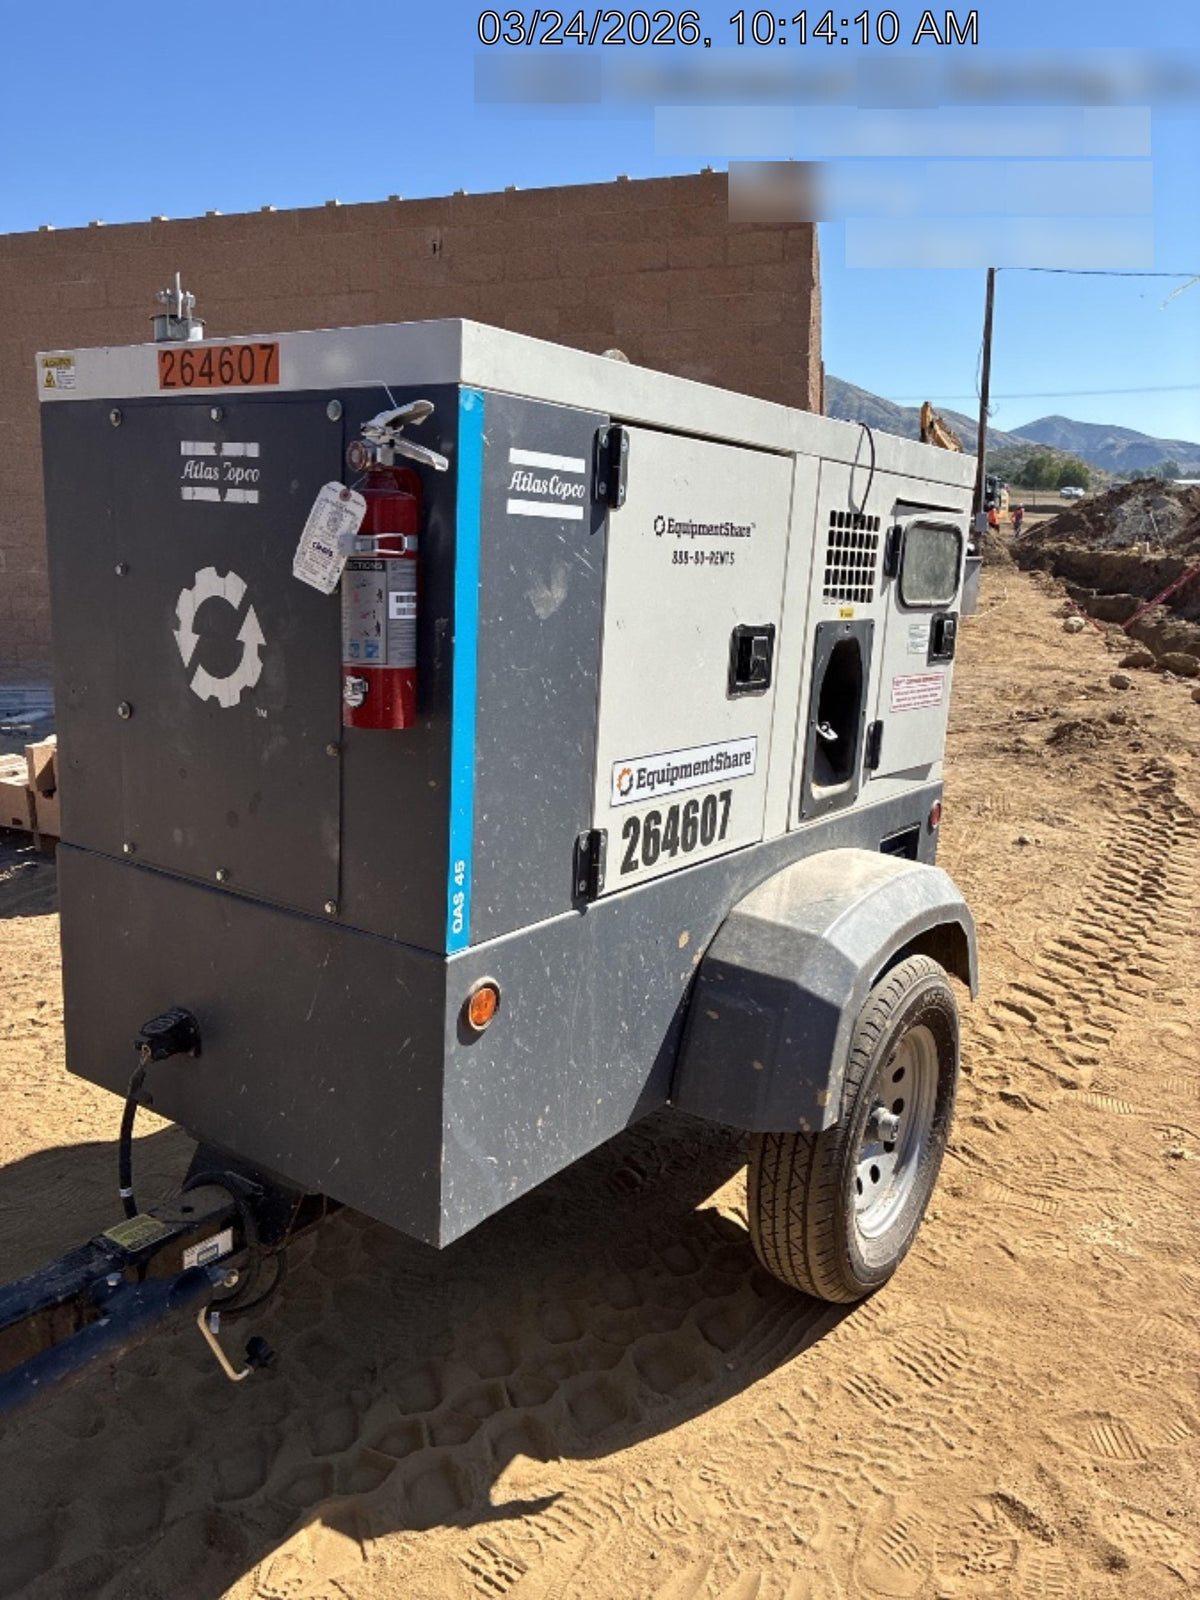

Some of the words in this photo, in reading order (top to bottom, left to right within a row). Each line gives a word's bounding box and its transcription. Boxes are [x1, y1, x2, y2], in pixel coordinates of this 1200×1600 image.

[161, 344, 275, 386] 264607
[180, 460, 219, 480] Atlas
[507, 470, 548, 494] Atlas
[548, 474, 585, 500] Copco
[667, 517, 751, 539] EquipmentShare
[636, 750, 751, 791] EquipmentShare
[620, 789, 733, 876] 264607
[454, 859, 466, 887] 45
